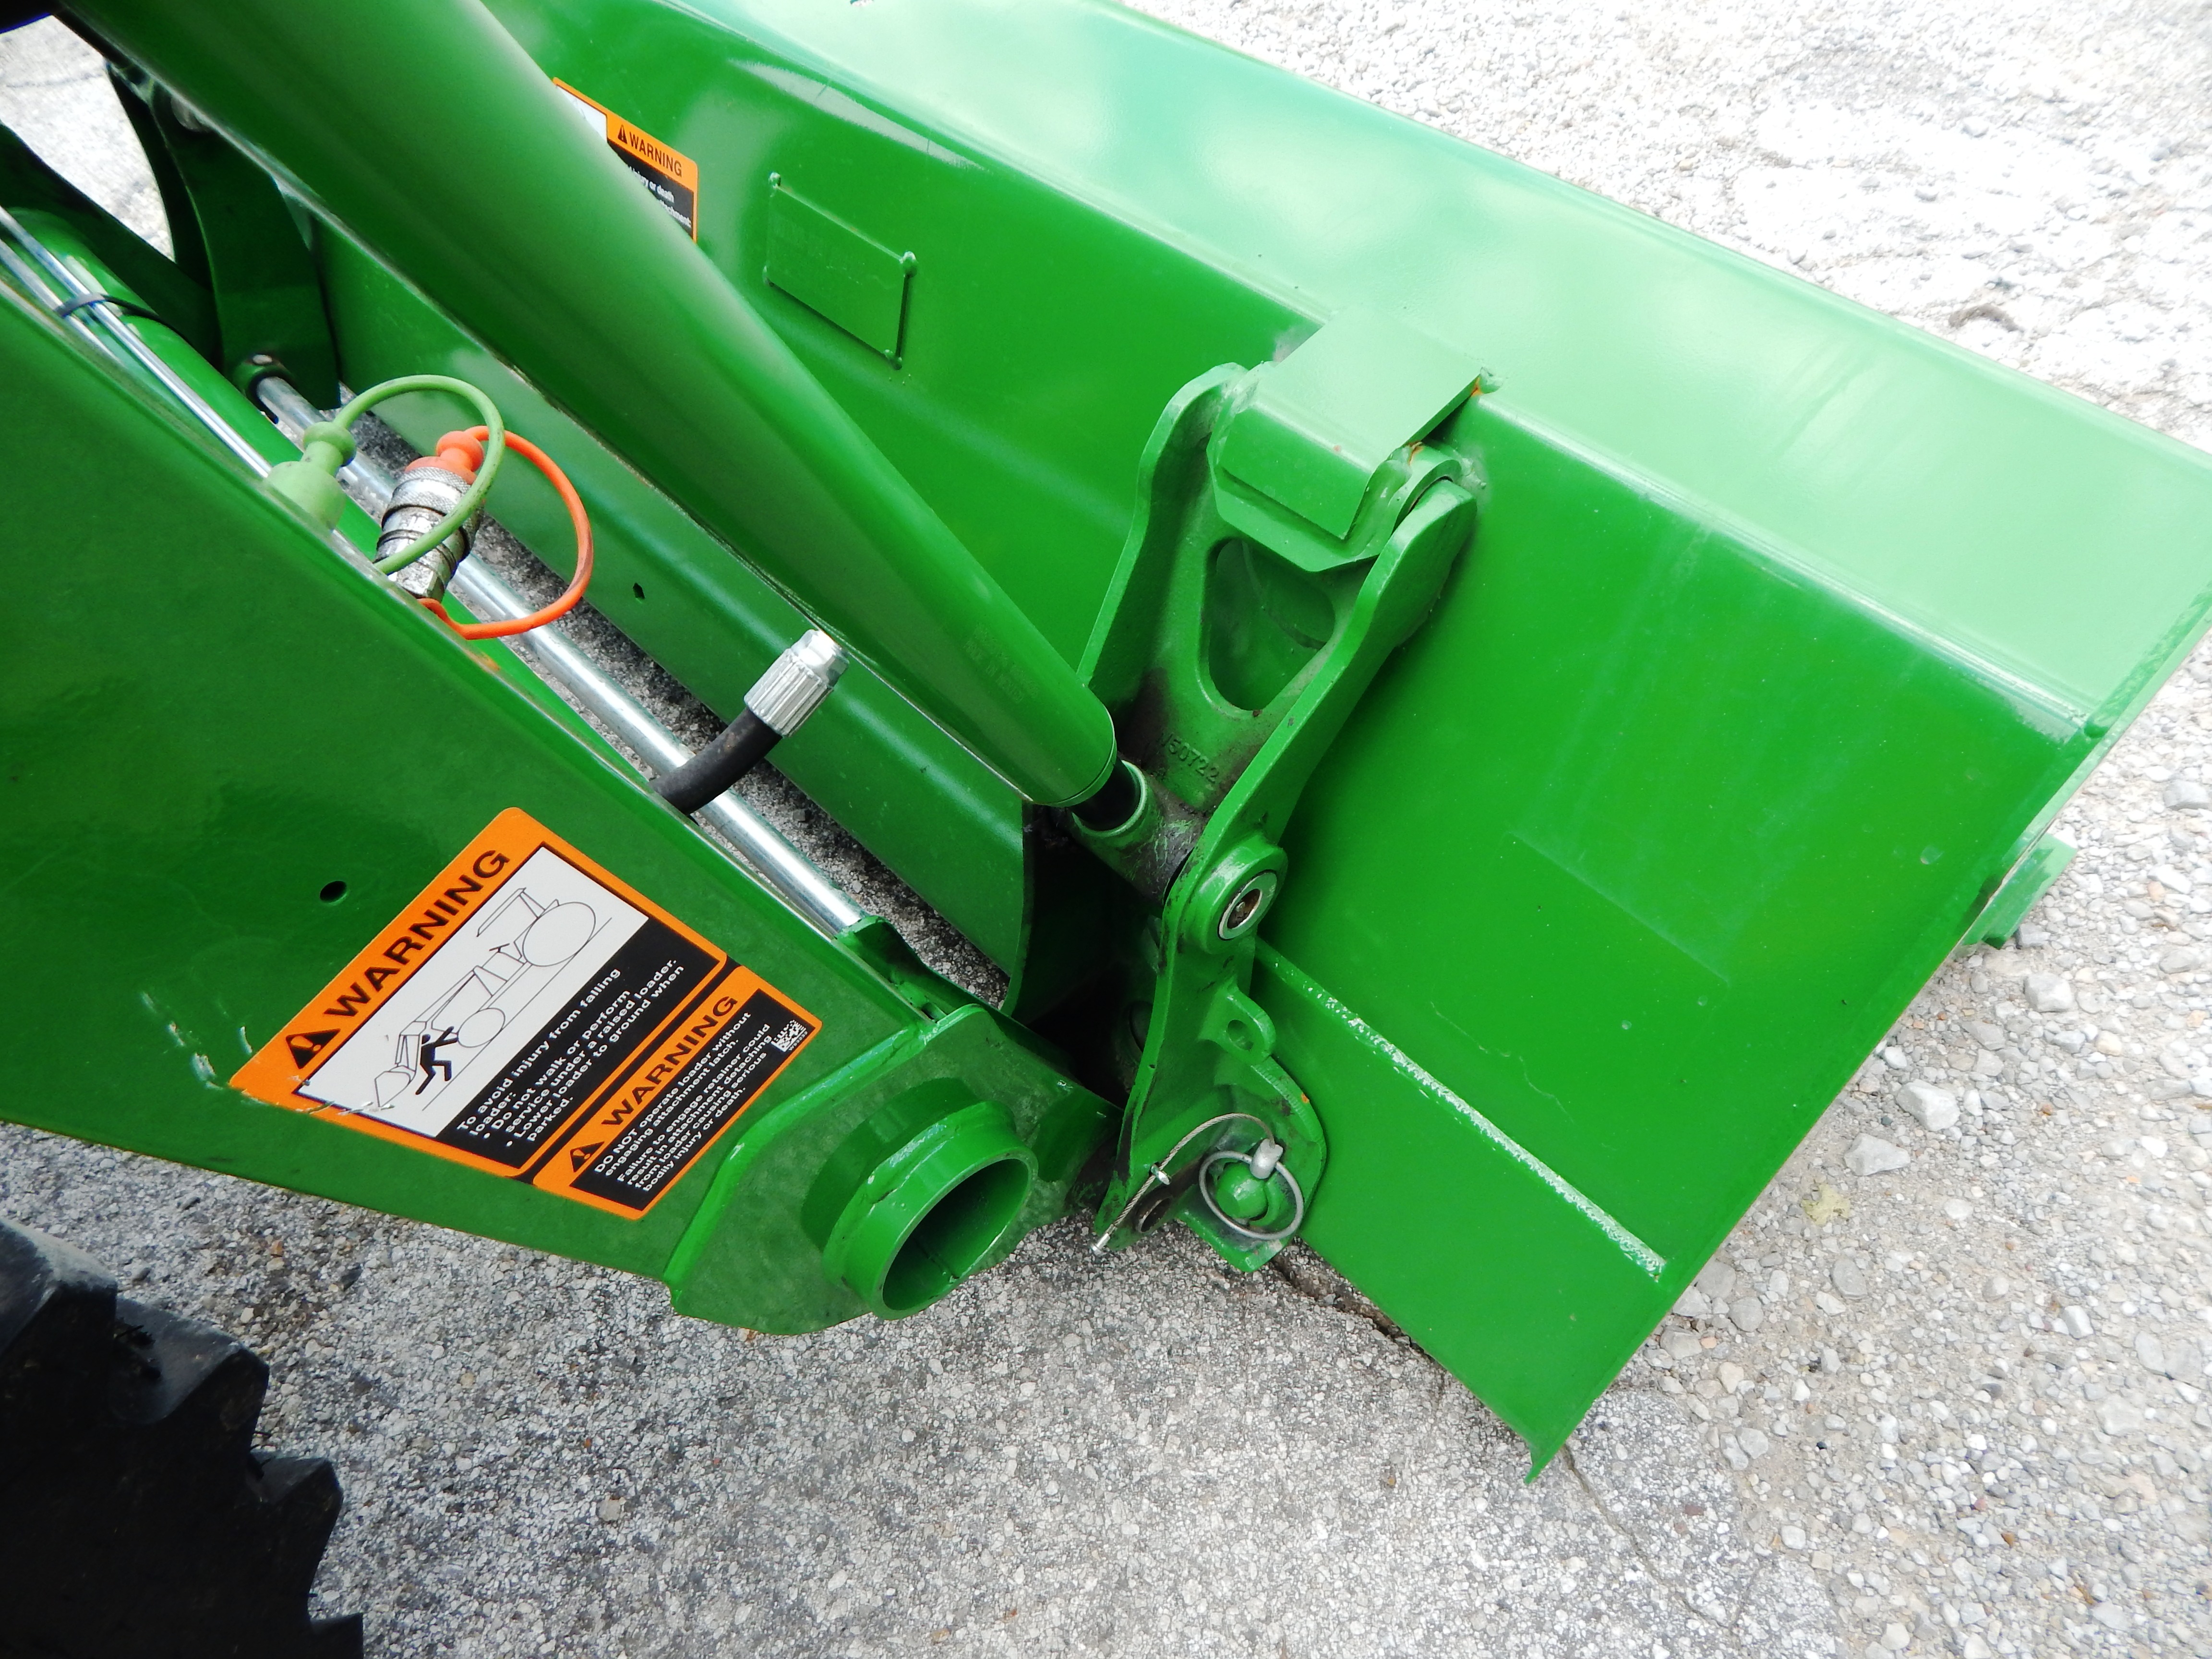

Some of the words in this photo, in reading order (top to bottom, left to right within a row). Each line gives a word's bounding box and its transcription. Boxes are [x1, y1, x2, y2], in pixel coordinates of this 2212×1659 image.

[629, 132, 682, 177] WARNING
[323, 850, 510, 1017] WARNING
[457, 1116, 477, 1130] To
[478, 1078, 513, 1113] avoid
[511, 1041, 549, 1077] injury
[549, 1010, 581, 1039] from
[580, 969, 621, 1007] falling
[469, 1092, 516, 1135] loader:
[491, 1112, 512, 1130] Do
[513, 1088, 536, 1109] not
[535, 1057, 566, 1085] walk
[567, 1040, 580, 1055] or
[582, 991, 630, 1040] perform
[505, 1089, 550, 1132] service
[551, 1050, 585, 1086] under
[588, 1041, 597, 1049] a
[597, 1000, 636, 1038] raised
[634, 960, 676, 999] loader.
[514, 1099, 553, 1138] Lower
[553, 1058, 592, 1098] loader
[593, 1045, 608, 1057] to
[609, 999, 651, 1043] ground
[651, 966, 684, 997] when
[594, 1155, 613, 1172] DO
[613, 1128, 637, 1154] NOT
[639, 1088, 679, 1128] operate
[677, 1052, 711, 1086] loader
[712, 1012, 751, 1051] without
[602, 996, 737, 1125] WARNING
[605, 1128, 653, 1176] engaging
[649, 1068, 710, 1127] attachment
[709, 1039, 739, 1067] latch.
[617, 1147, 653, 1182] Failure
[652, 1134, 665, 1145] to
[666, 1095, 703, 1132] engage
[703, 1053, 741, 1094] retainer
[743, 1023, 770, 1053] could
[627, 1156, 657, 1185] result
[655, 1144, 668, 1154] in
[668, 1086, 724, 1143] attachment
[724, 1035, 772, 1084] detaching
[527, 1097, 573, 1142] parked.
[635, 1165, 661, 1188] from
[659, 1130, 691, 1163] loader
[690, 1090, 732, 1129] causing
[731, 1053, 767, 1089] serious
[642, 1160, 674, 1191] bodily
[673, 1131, 702, 1159] injury
[703, 1118, 713, 1130] or
[715, 1087, 745, 1118] death.
